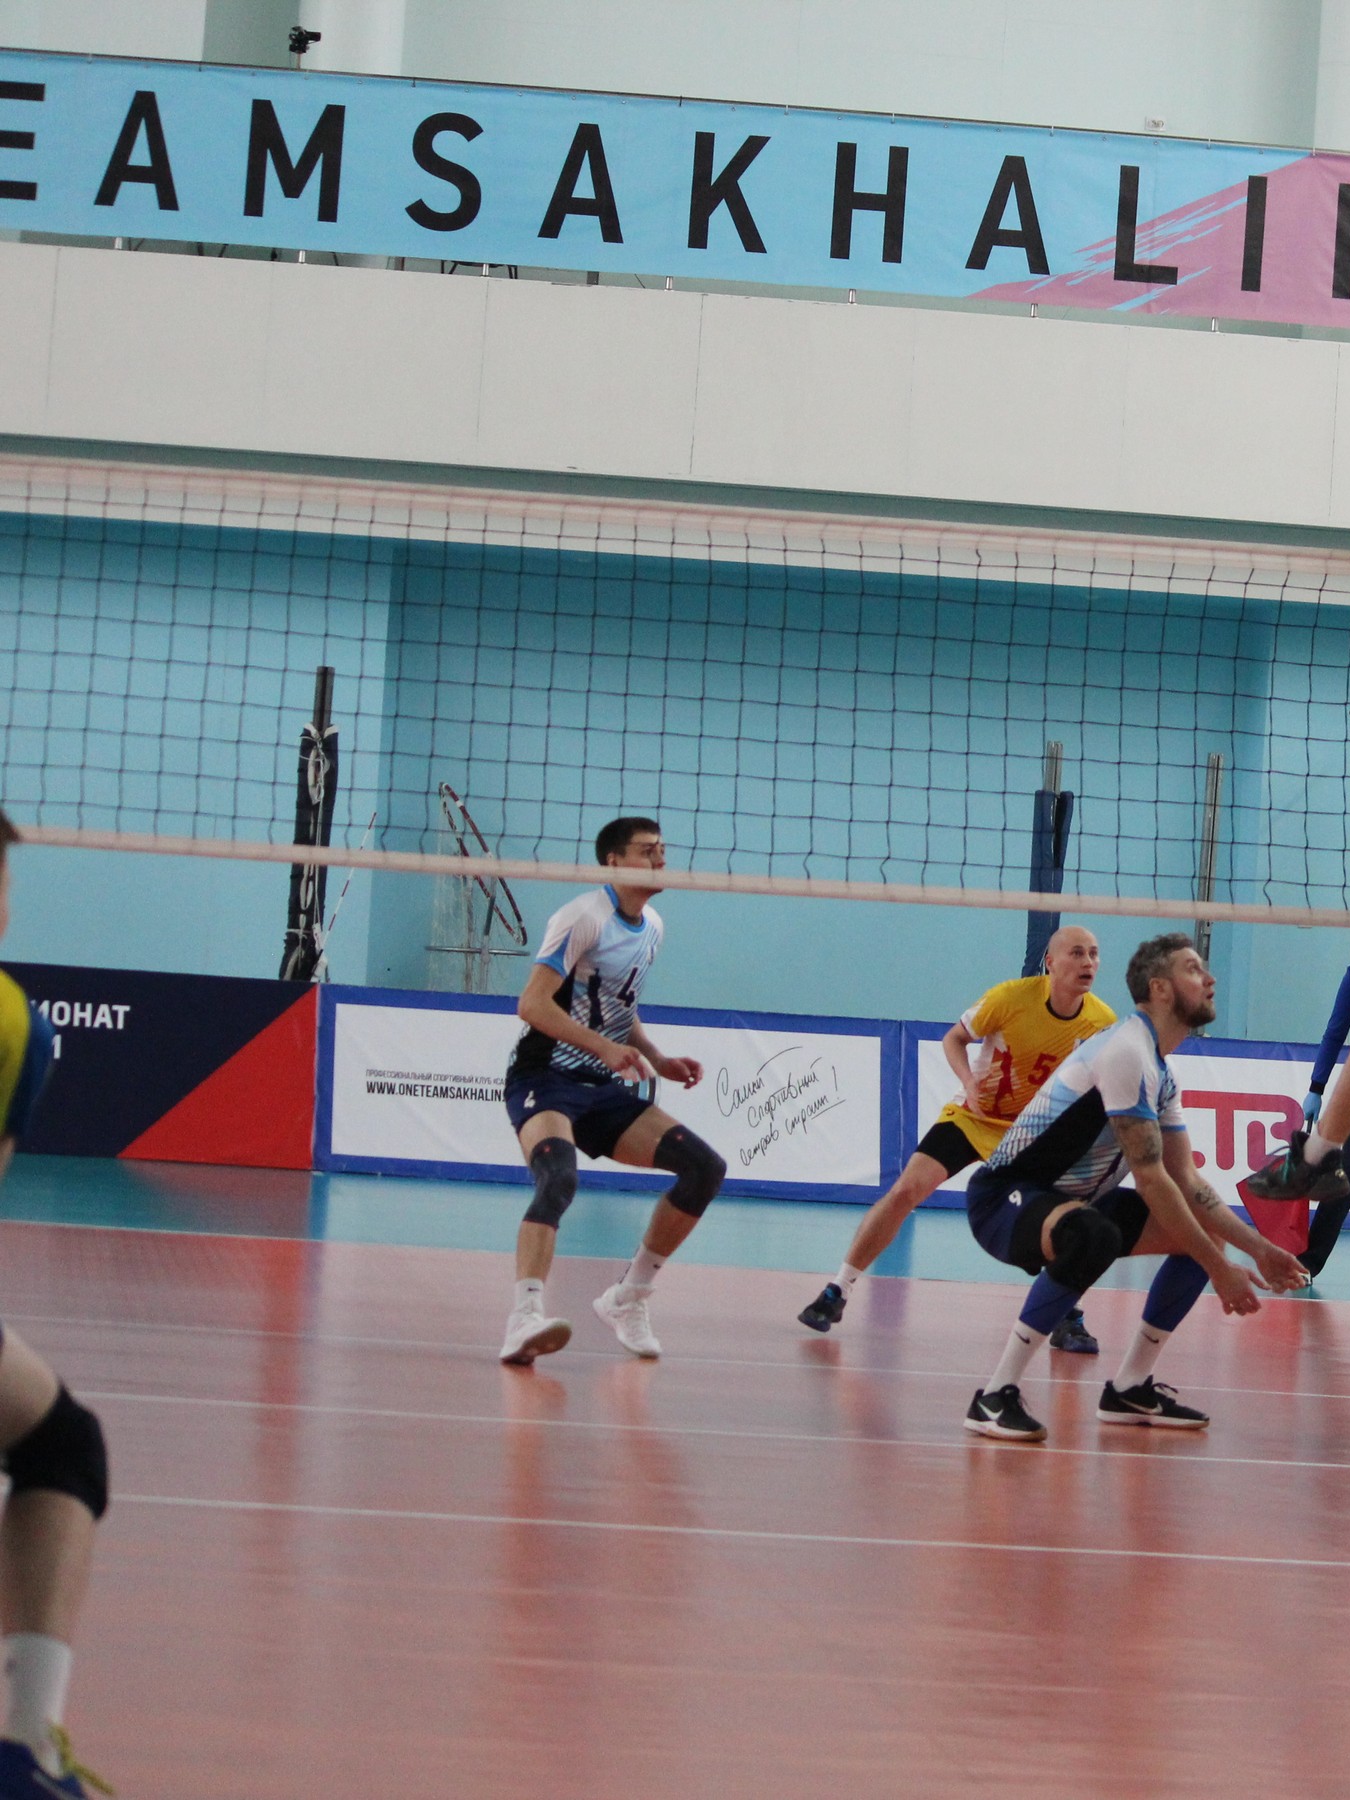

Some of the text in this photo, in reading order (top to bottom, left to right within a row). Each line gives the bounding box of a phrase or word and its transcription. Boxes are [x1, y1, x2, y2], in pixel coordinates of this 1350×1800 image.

[615, 966, 639, 1009] 4
[365, 1068, 433, 1081] ПРОФЕССИОНАЛЬНЫЙ
[433, 1073, 474, 1083] СПОРТИВНЫЙ
[474, 1076, 492, 1085] КЛУБ
[1027, 1051, 1058, 1086] 5
[366, 1081, 506, 1102] WWW.ONETEAMSAKHALIN.
[1008, 1189, 1023, 1207] 9
